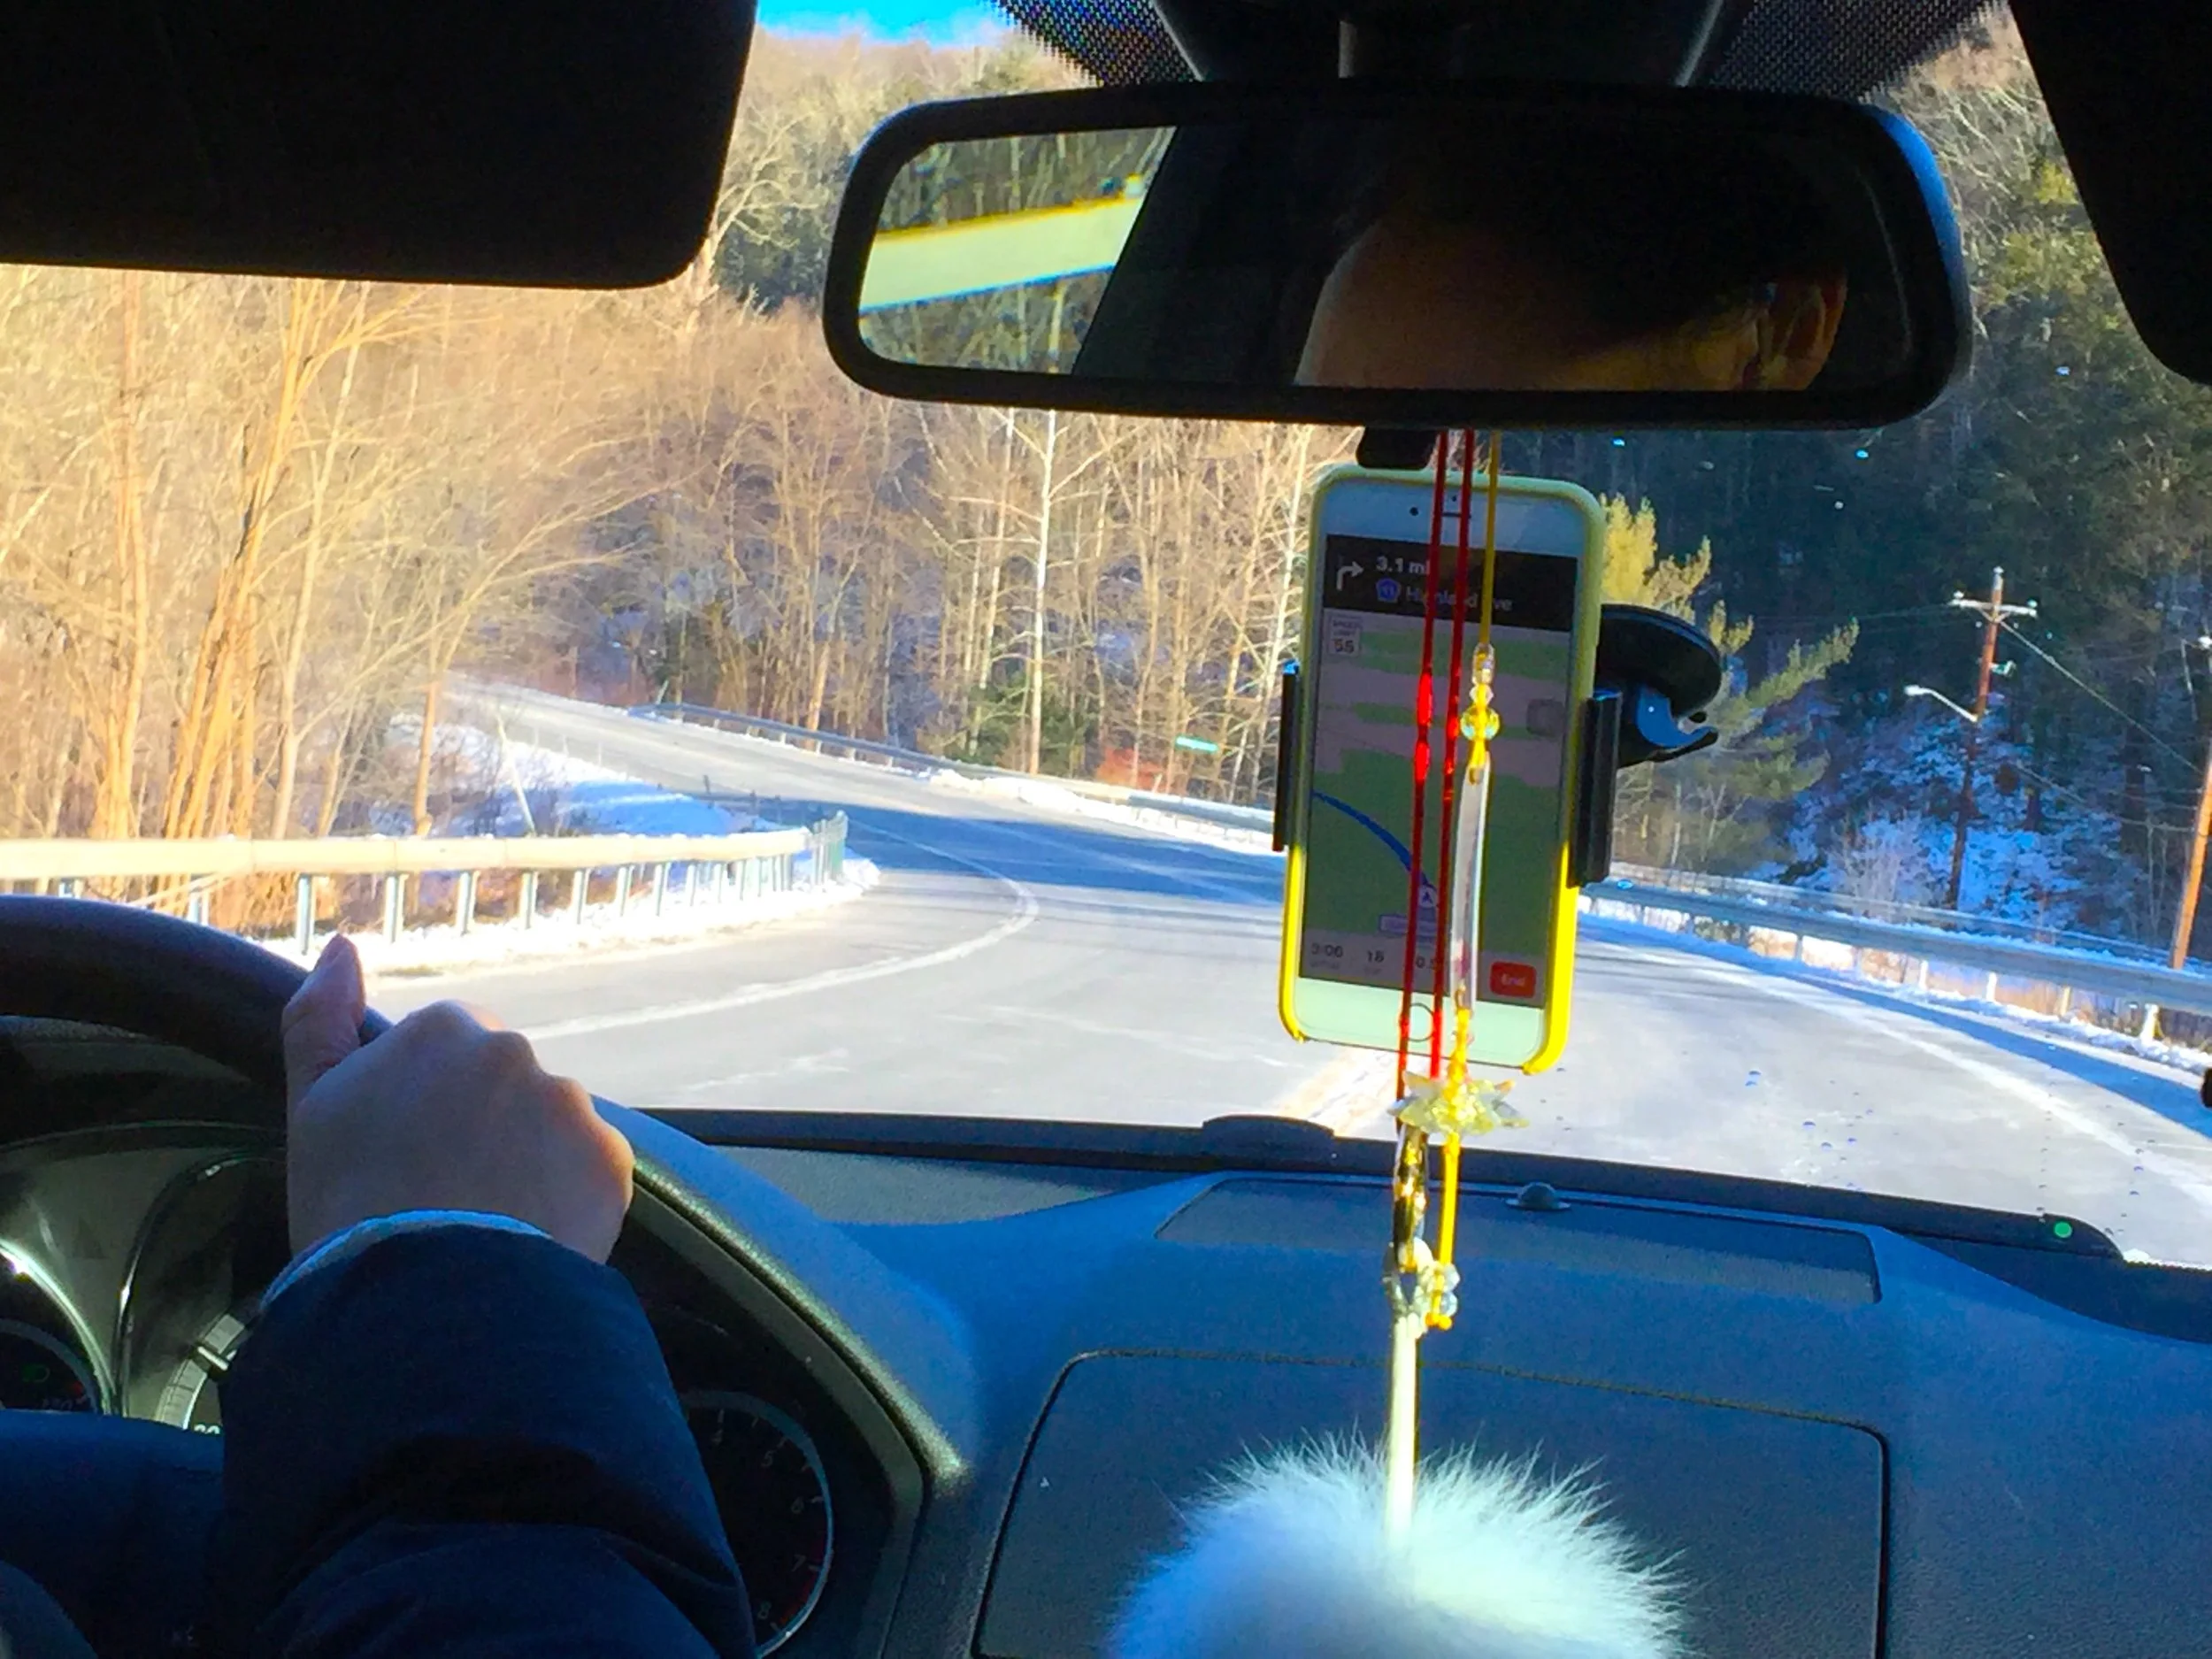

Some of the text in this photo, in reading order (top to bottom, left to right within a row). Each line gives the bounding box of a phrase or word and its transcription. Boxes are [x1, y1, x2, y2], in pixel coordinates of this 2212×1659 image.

[1375, 556, 1402, 573] 3.1
[761, 1451, 772, 1468] 5
[789, 1496, 803, 1515] 6
[791, 1555, 806, 1572] 7
[757, 1601, 770, 1619] 8
